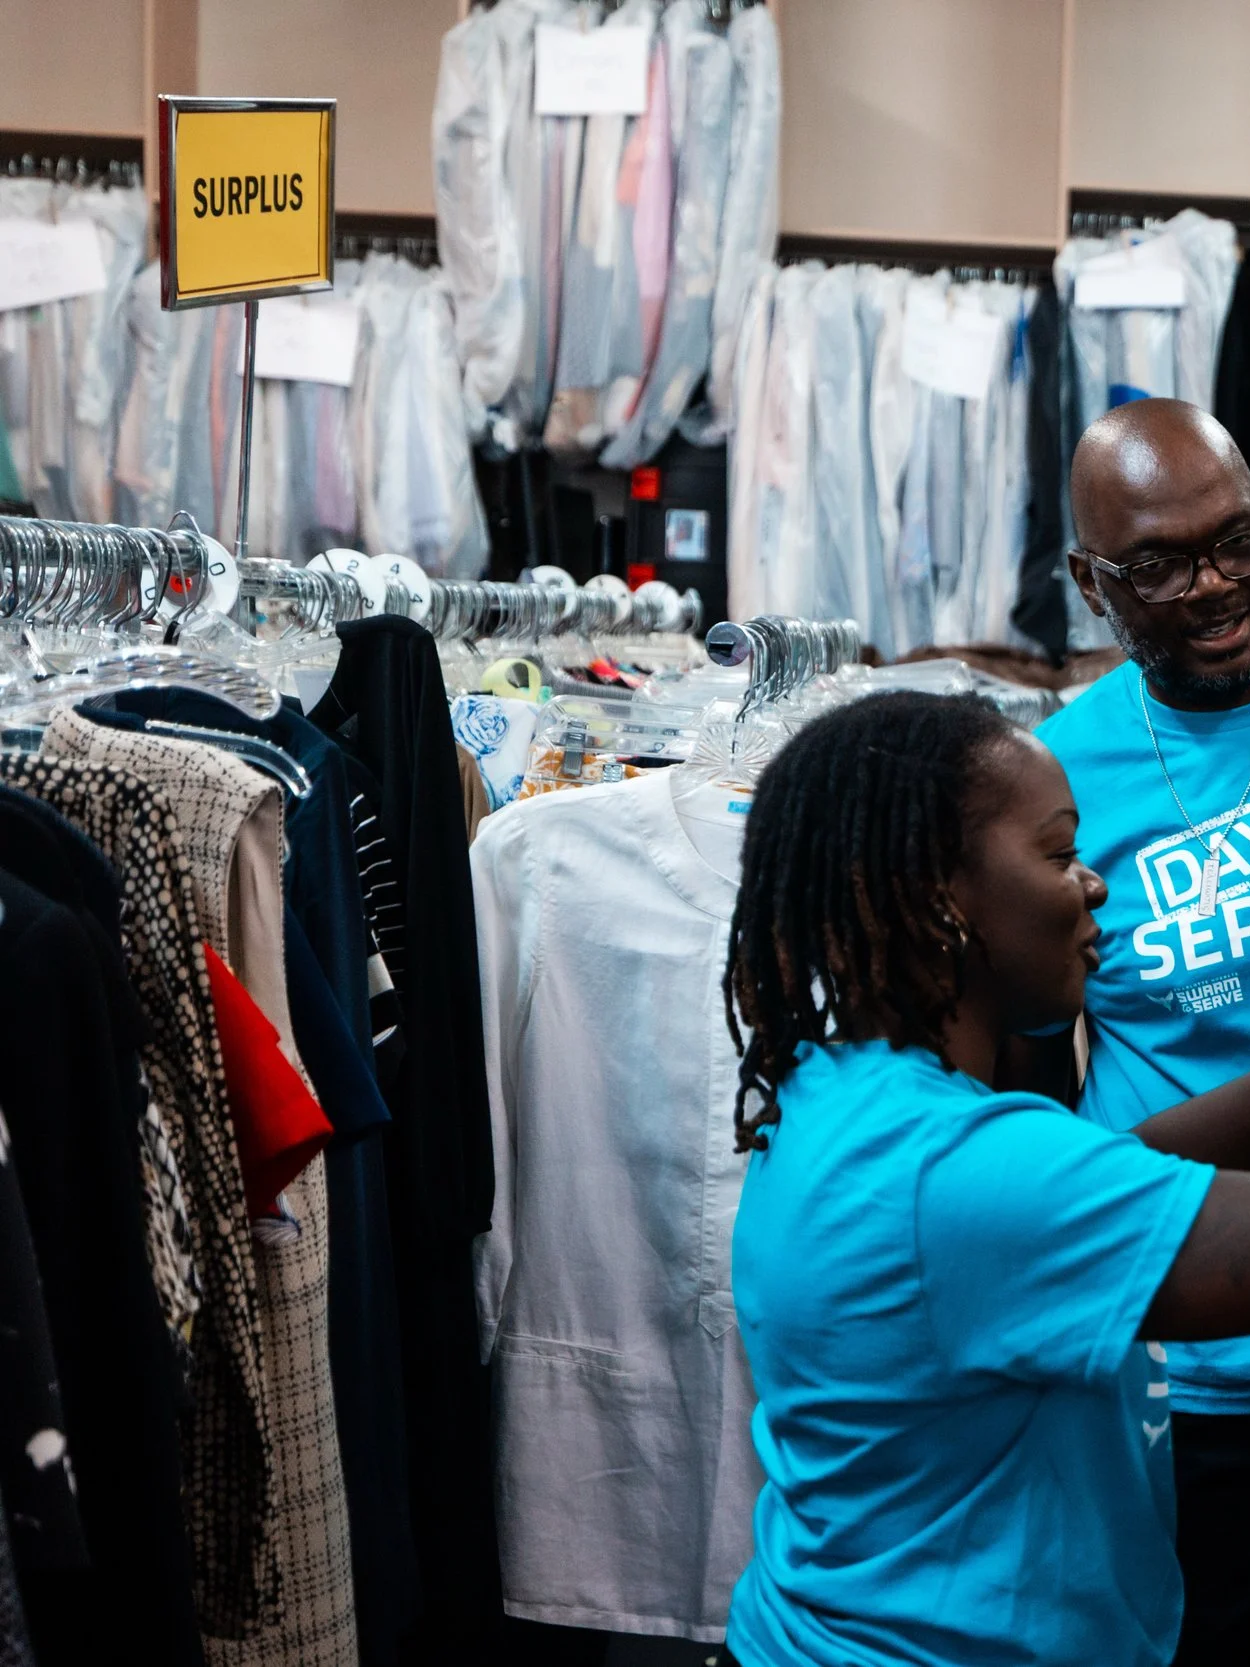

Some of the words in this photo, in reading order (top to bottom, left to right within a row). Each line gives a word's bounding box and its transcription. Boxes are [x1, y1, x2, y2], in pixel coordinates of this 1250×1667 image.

[193, 173, 303, 218] SURPLUS
[346, 560, 360, 573] 2
[389, 563, 401, 575] 4
[1176, 977, 1241, 1003] SWARM
[1191, 989, 1244, 1014] SERVE
